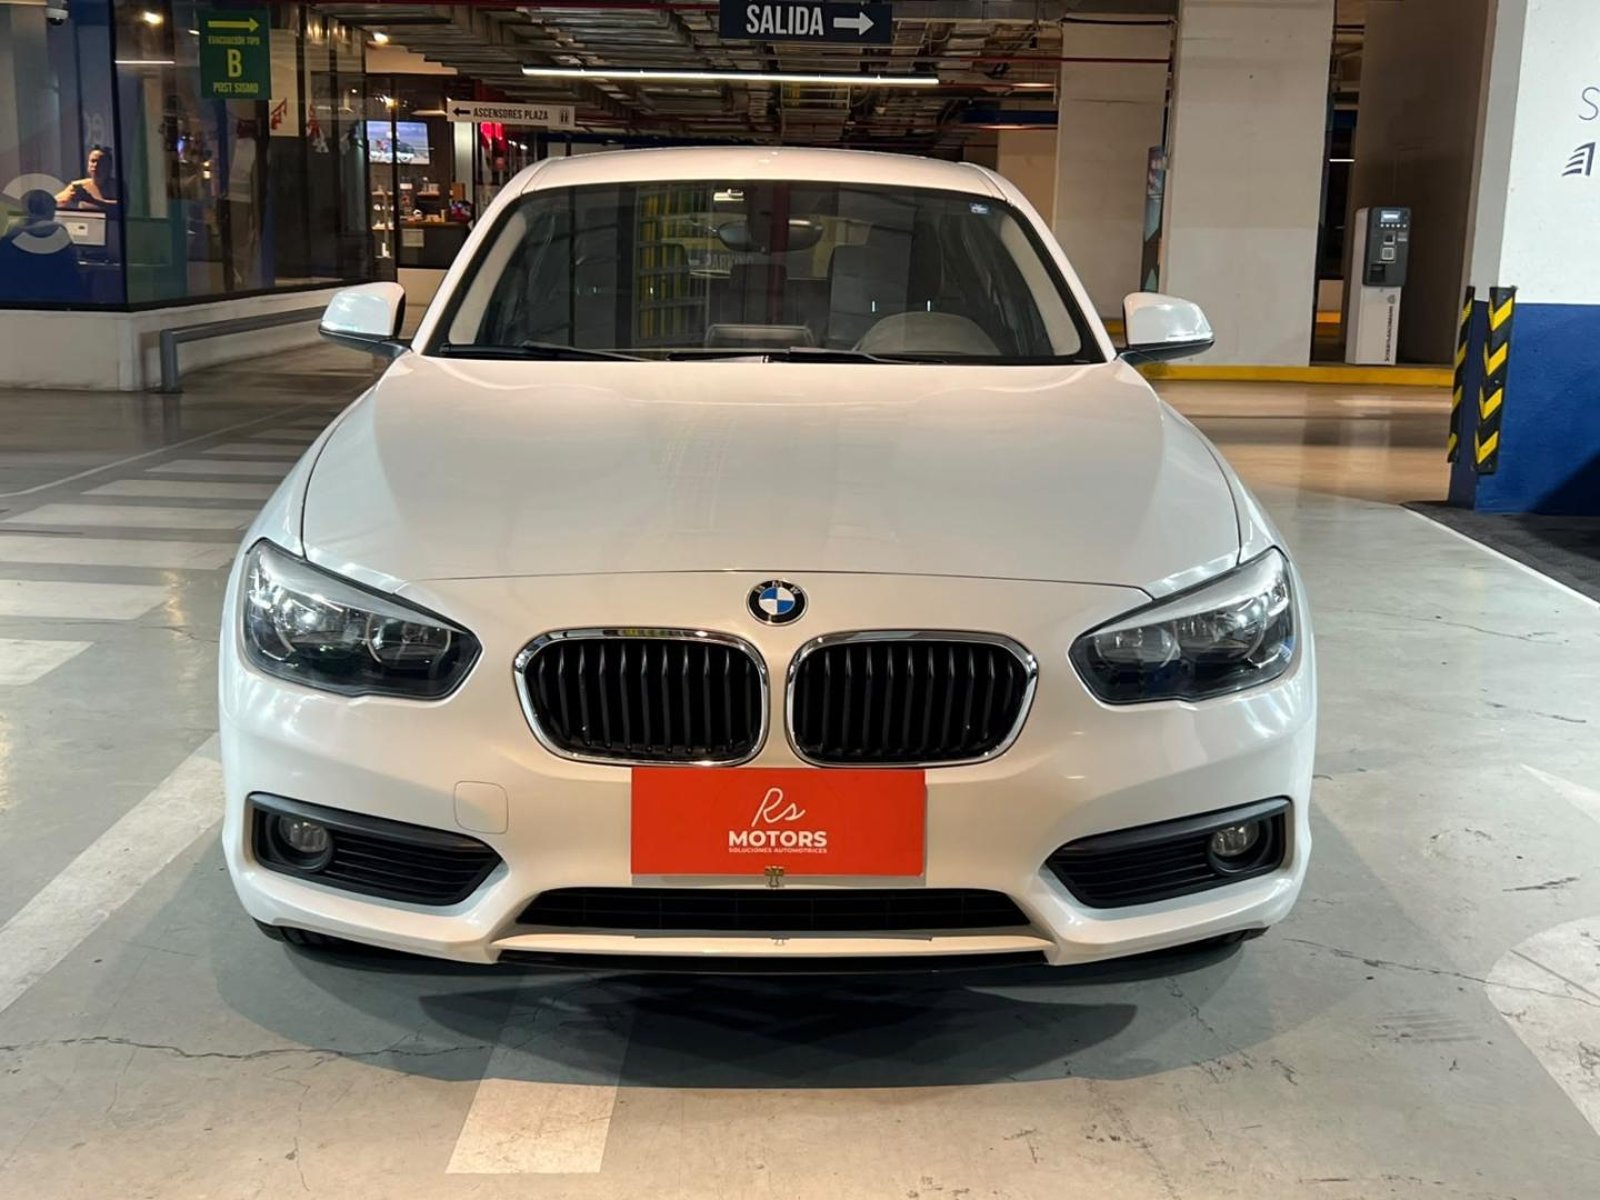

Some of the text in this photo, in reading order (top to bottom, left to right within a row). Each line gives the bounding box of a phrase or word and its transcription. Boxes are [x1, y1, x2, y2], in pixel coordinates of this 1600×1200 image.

[746, 4, 824, 36] SALIDA
[227, 48, 243, 78] B
[473, 107, 549, 120] ASCENSORES PLAZA
[751, 787, 806, 827] Rs
[728, 830, 828, 847] MOTORS
